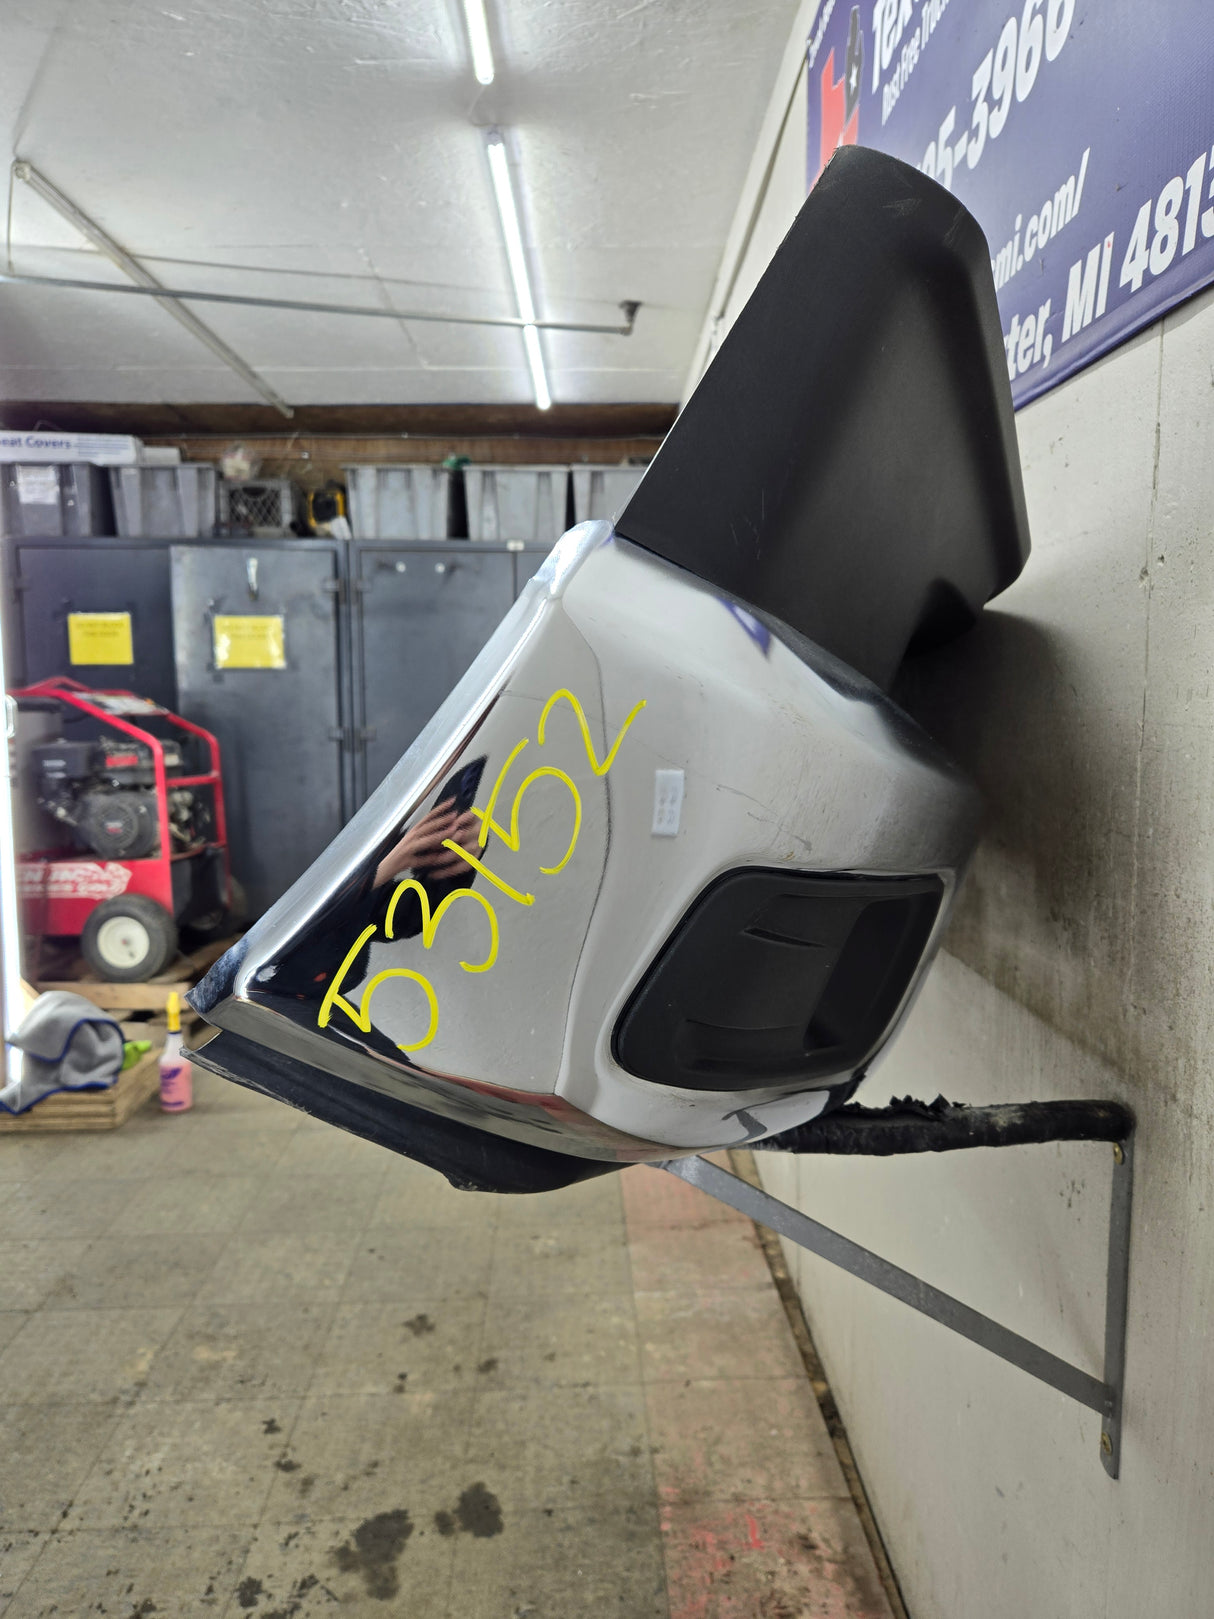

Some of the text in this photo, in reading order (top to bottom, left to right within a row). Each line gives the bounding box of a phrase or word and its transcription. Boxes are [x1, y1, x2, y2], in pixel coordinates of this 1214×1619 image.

[901, 27, 920, 90] Free
[991, 146, 1090, 292] mi.com/
[1004, 298, 1052, 381] ter,
[1061, 231, 1115, 343] MI
[0, 437, 22, 448] eat
[25, 435, 72, 449] Covers
[318, 688, 647, 1051] 53152
